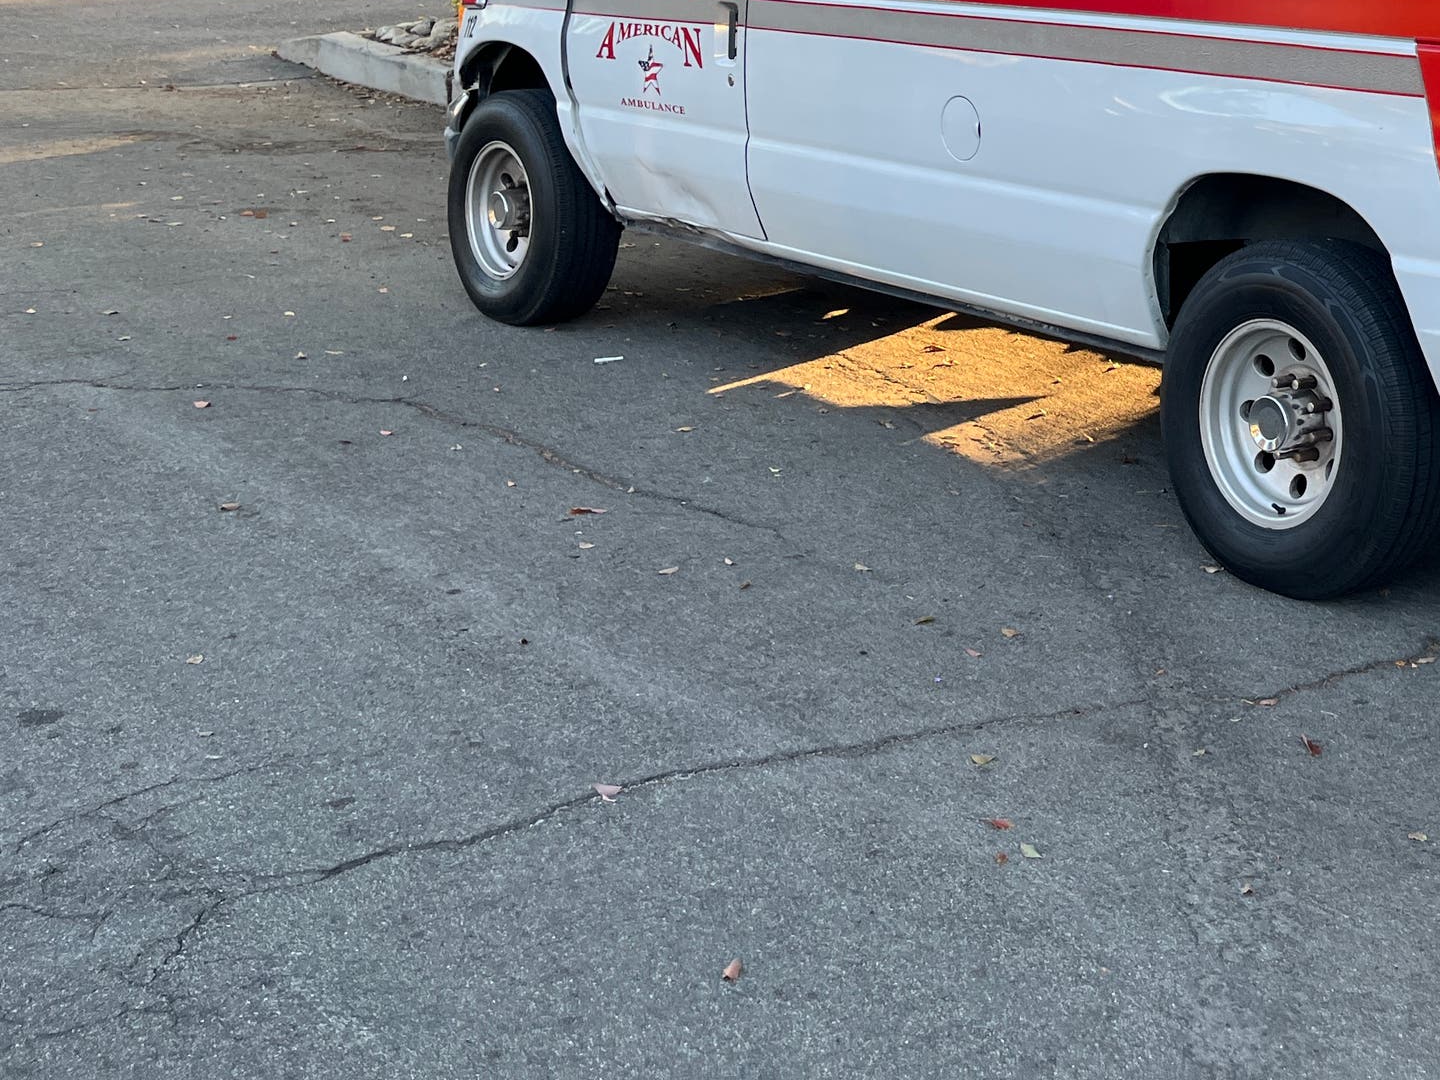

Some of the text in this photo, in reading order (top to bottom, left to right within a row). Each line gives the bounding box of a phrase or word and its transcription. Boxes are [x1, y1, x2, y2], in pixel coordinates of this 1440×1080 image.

[464, 15, 478, 38] 112
[596, 21, 703, 69] AMERICAN
[620, 97, 686, 115] AMBULANCE
